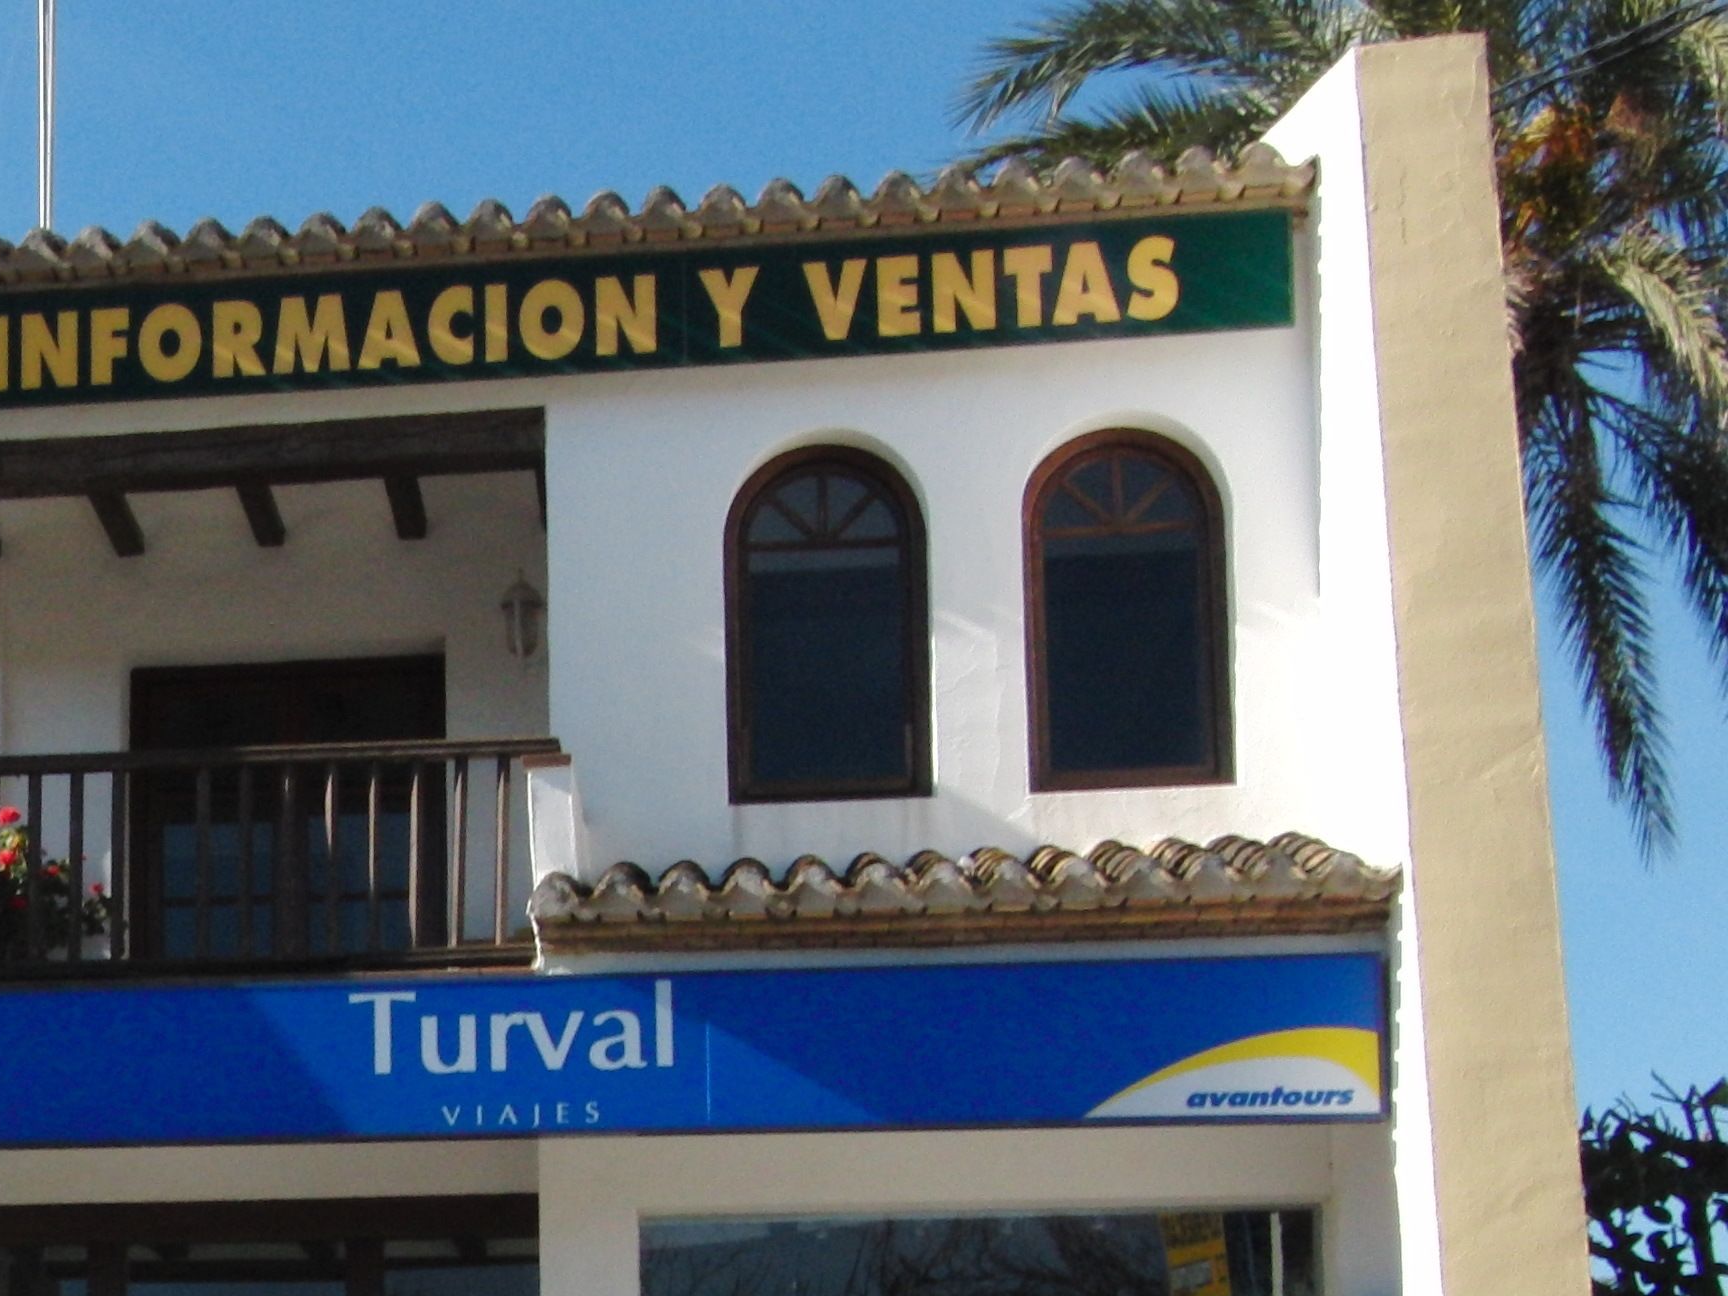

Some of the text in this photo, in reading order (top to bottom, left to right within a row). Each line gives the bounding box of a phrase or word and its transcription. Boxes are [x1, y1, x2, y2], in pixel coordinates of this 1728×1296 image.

[699, 266, 760, 348] Y
[803, 235, 1180, 341] VENTAS
[348, 980, 673, 1075] Turval
[441, 1100, 601, 1128] VIAJES
[1186, 1086, 1355, 1108] avantours
